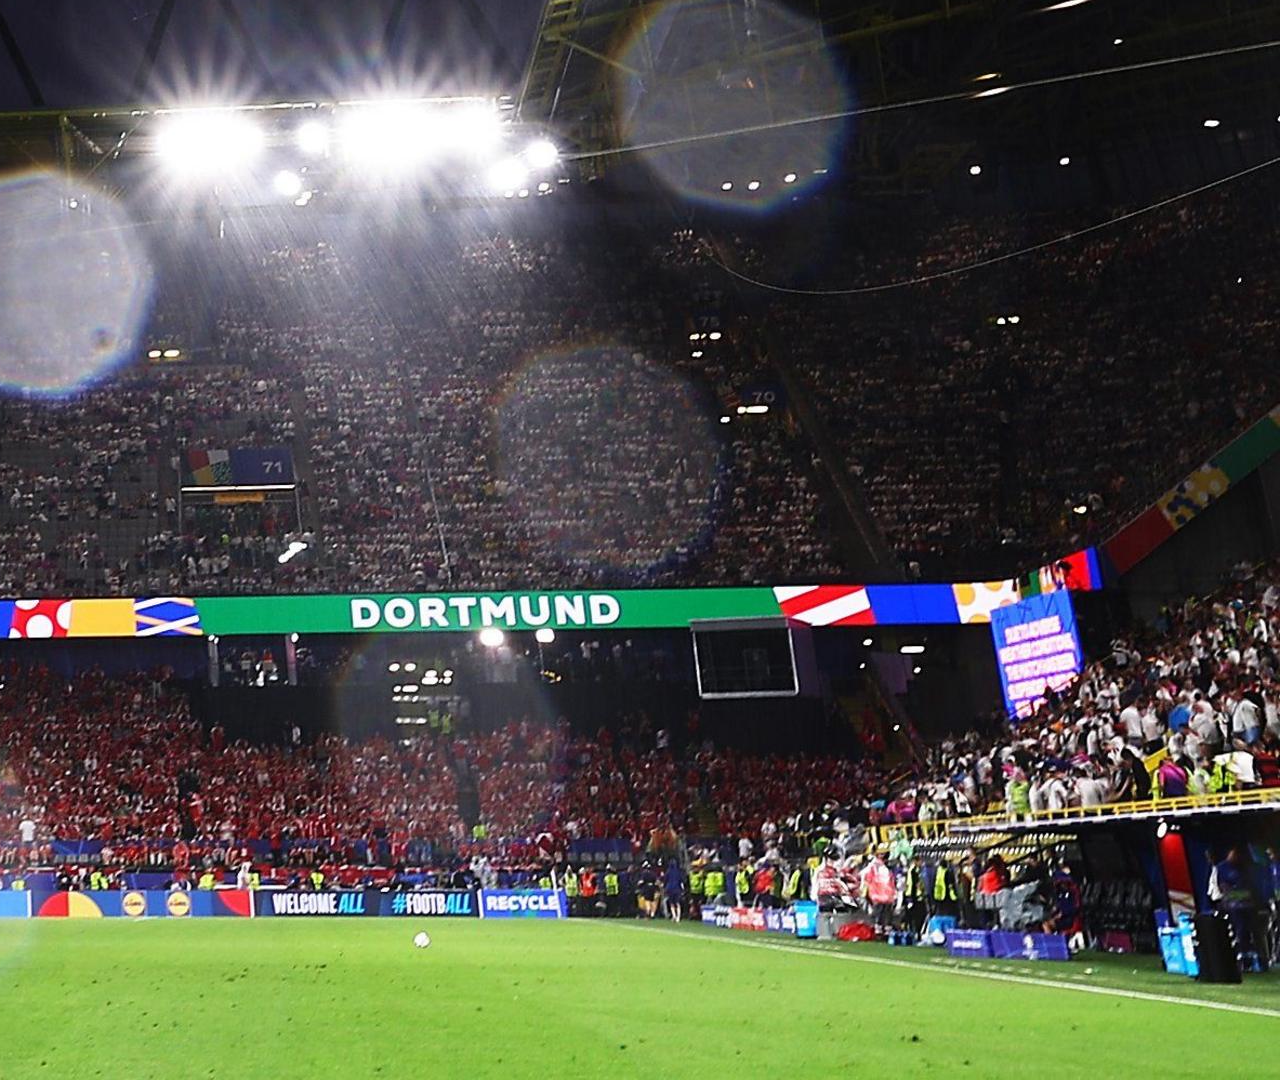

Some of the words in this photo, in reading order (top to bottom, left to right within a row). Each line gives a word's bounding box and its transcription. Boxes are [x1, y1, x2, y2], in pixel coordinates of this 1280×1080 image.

[262, 461, 282, 473] 71
[350, 594, 620, 629] DORTMUND
[392, 893, 472, 914] #FOOTBALL
[487, 891, 559, 911] RECYCLE
